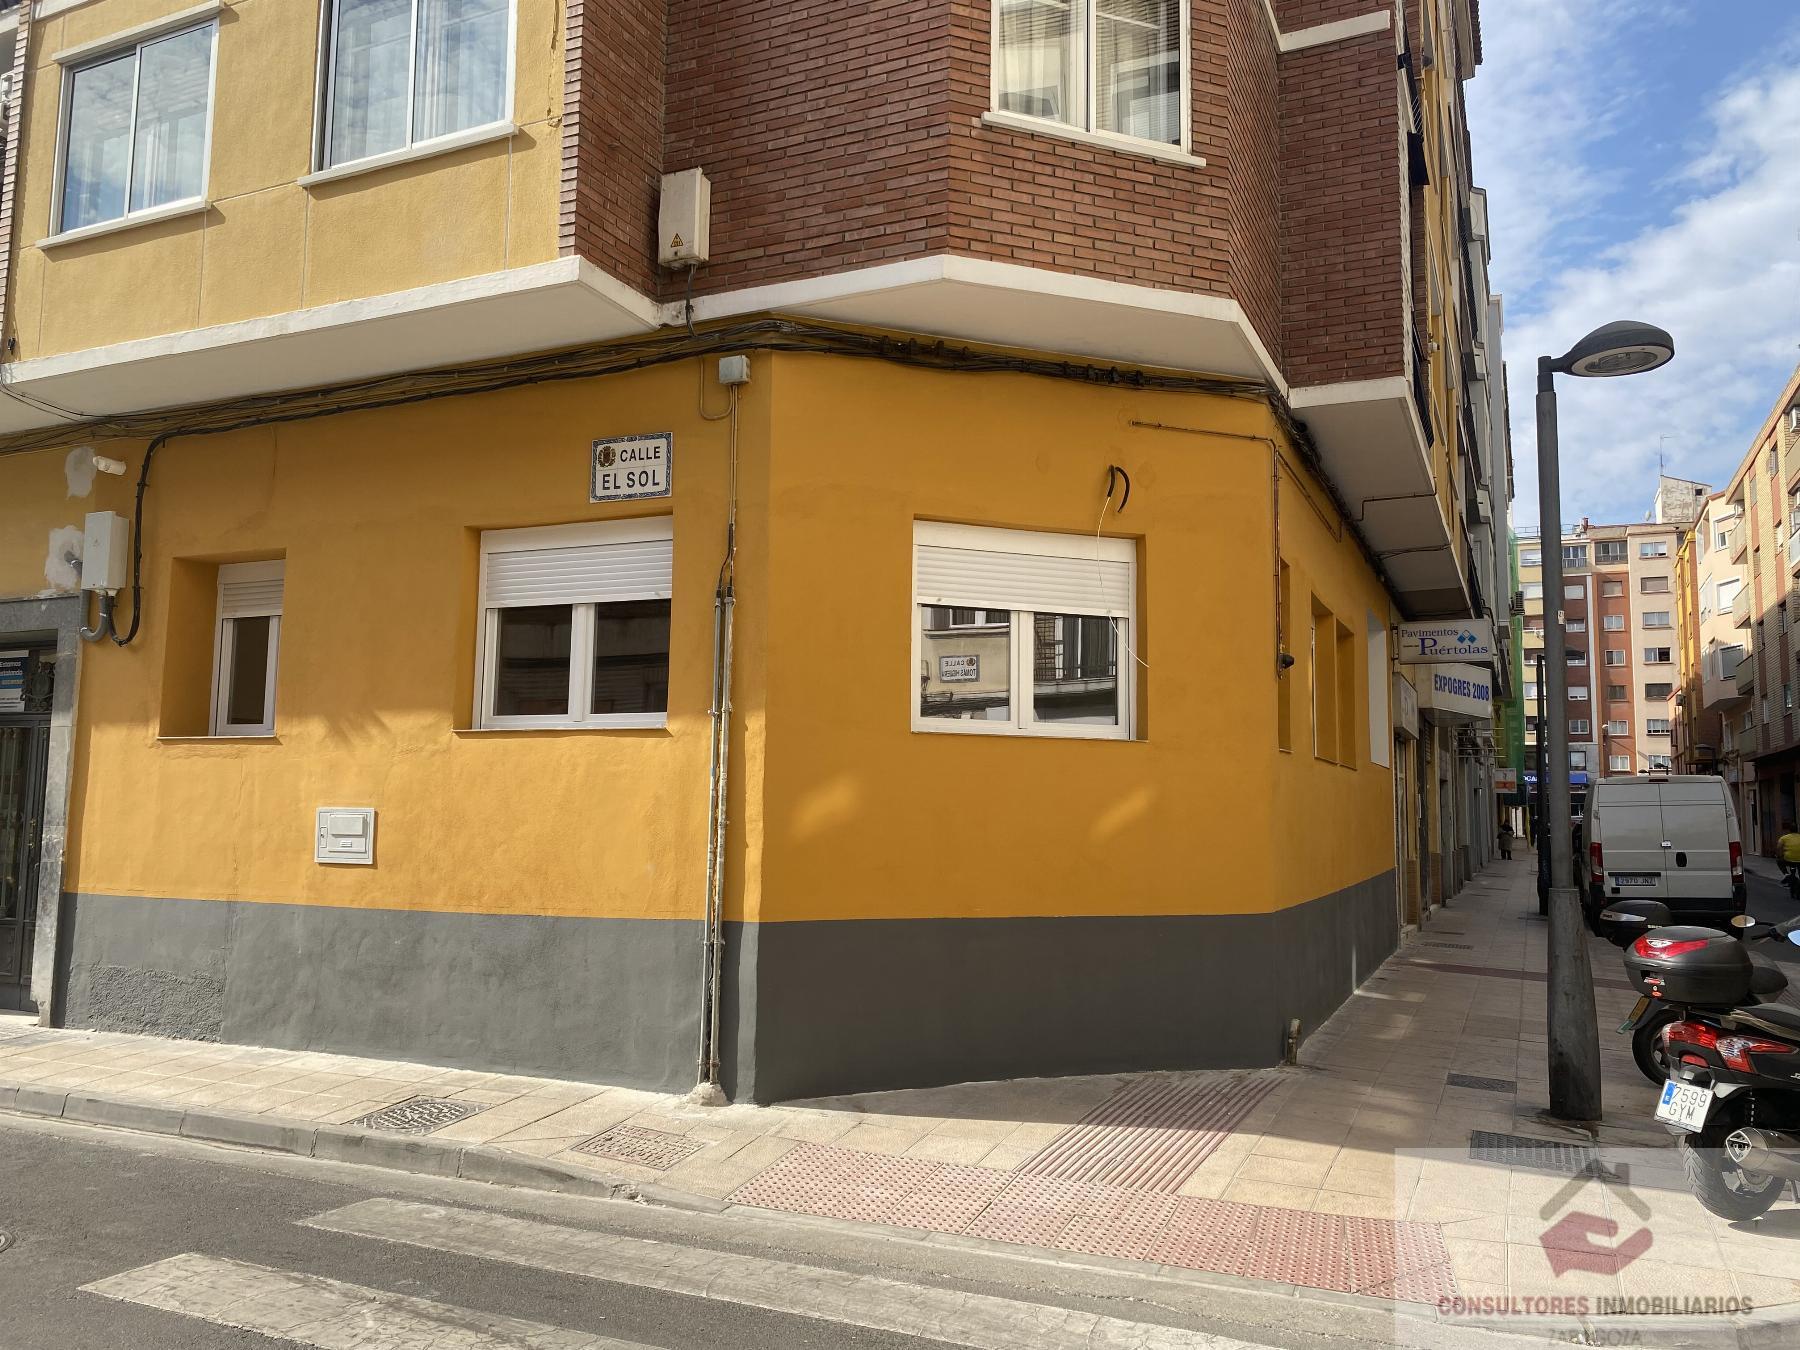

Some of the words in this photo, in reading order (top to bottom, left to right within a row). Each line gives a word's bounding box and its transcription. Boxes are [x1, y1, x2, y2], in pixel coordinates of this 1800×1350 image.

[620, 446, 661, 462] CALLE
[602, 473, 621, 490] EL
[626, 469, 660, 488] SOL
[1401, 628, 1459, 638] Pavimentos
[1418, 637, 1489, 656] Puértolas
[1434, 674, 1471, 698] EXPOGRES
[1472, 683, 1490, 701] 2008
[1671, 1086, 1707, 1107] 7599
[1668, 1101, 1696, 1120] GYM
